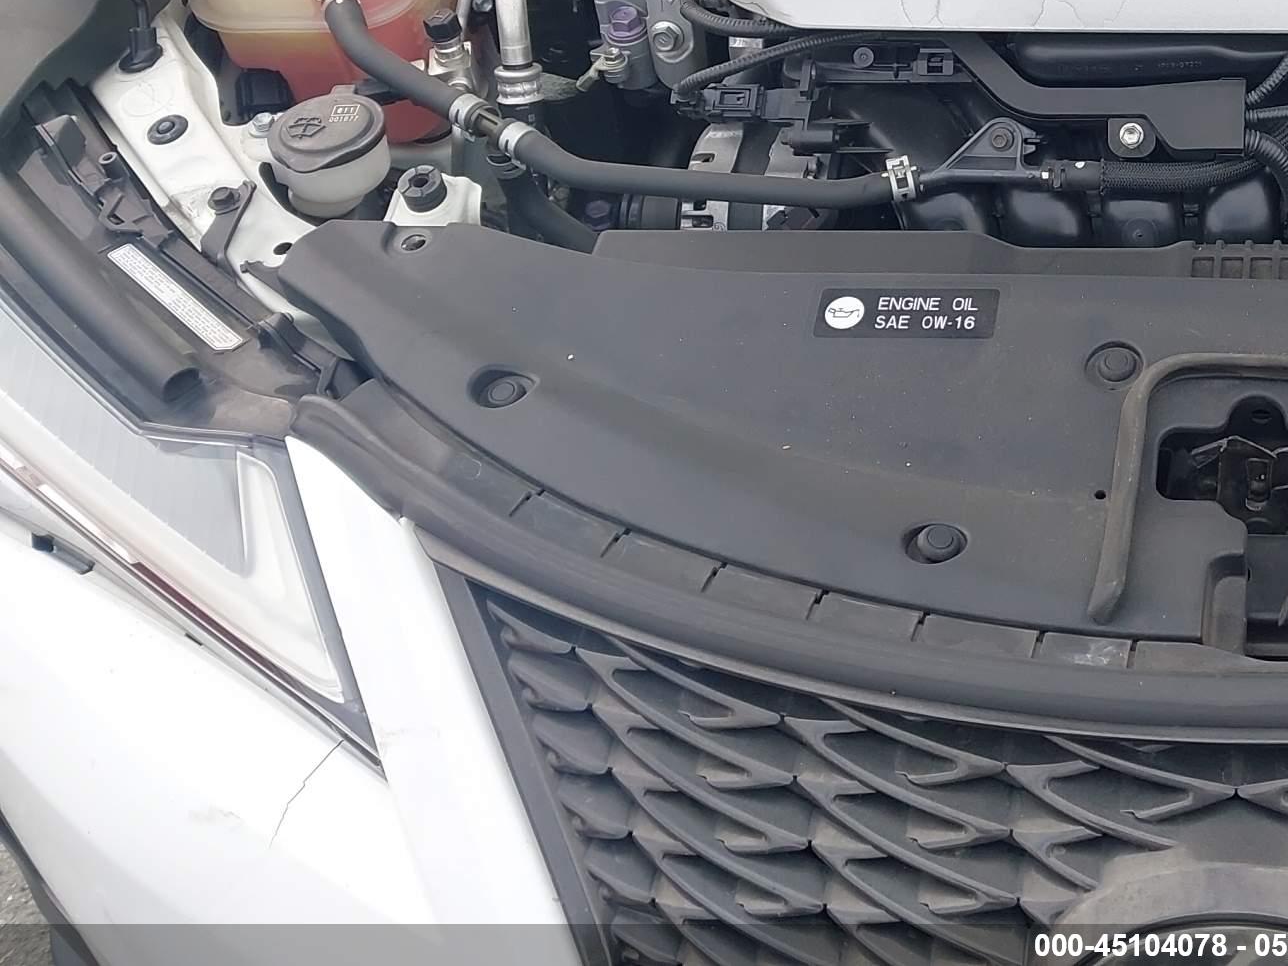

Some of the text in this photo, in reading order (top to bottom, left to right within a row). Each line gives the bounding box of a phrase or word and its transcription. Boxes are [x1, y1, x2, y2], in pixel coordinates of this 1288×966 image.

[877, 297, 978, 311] ENGINE OIL
[874, 316, 976, 330] SAE 0W-16
